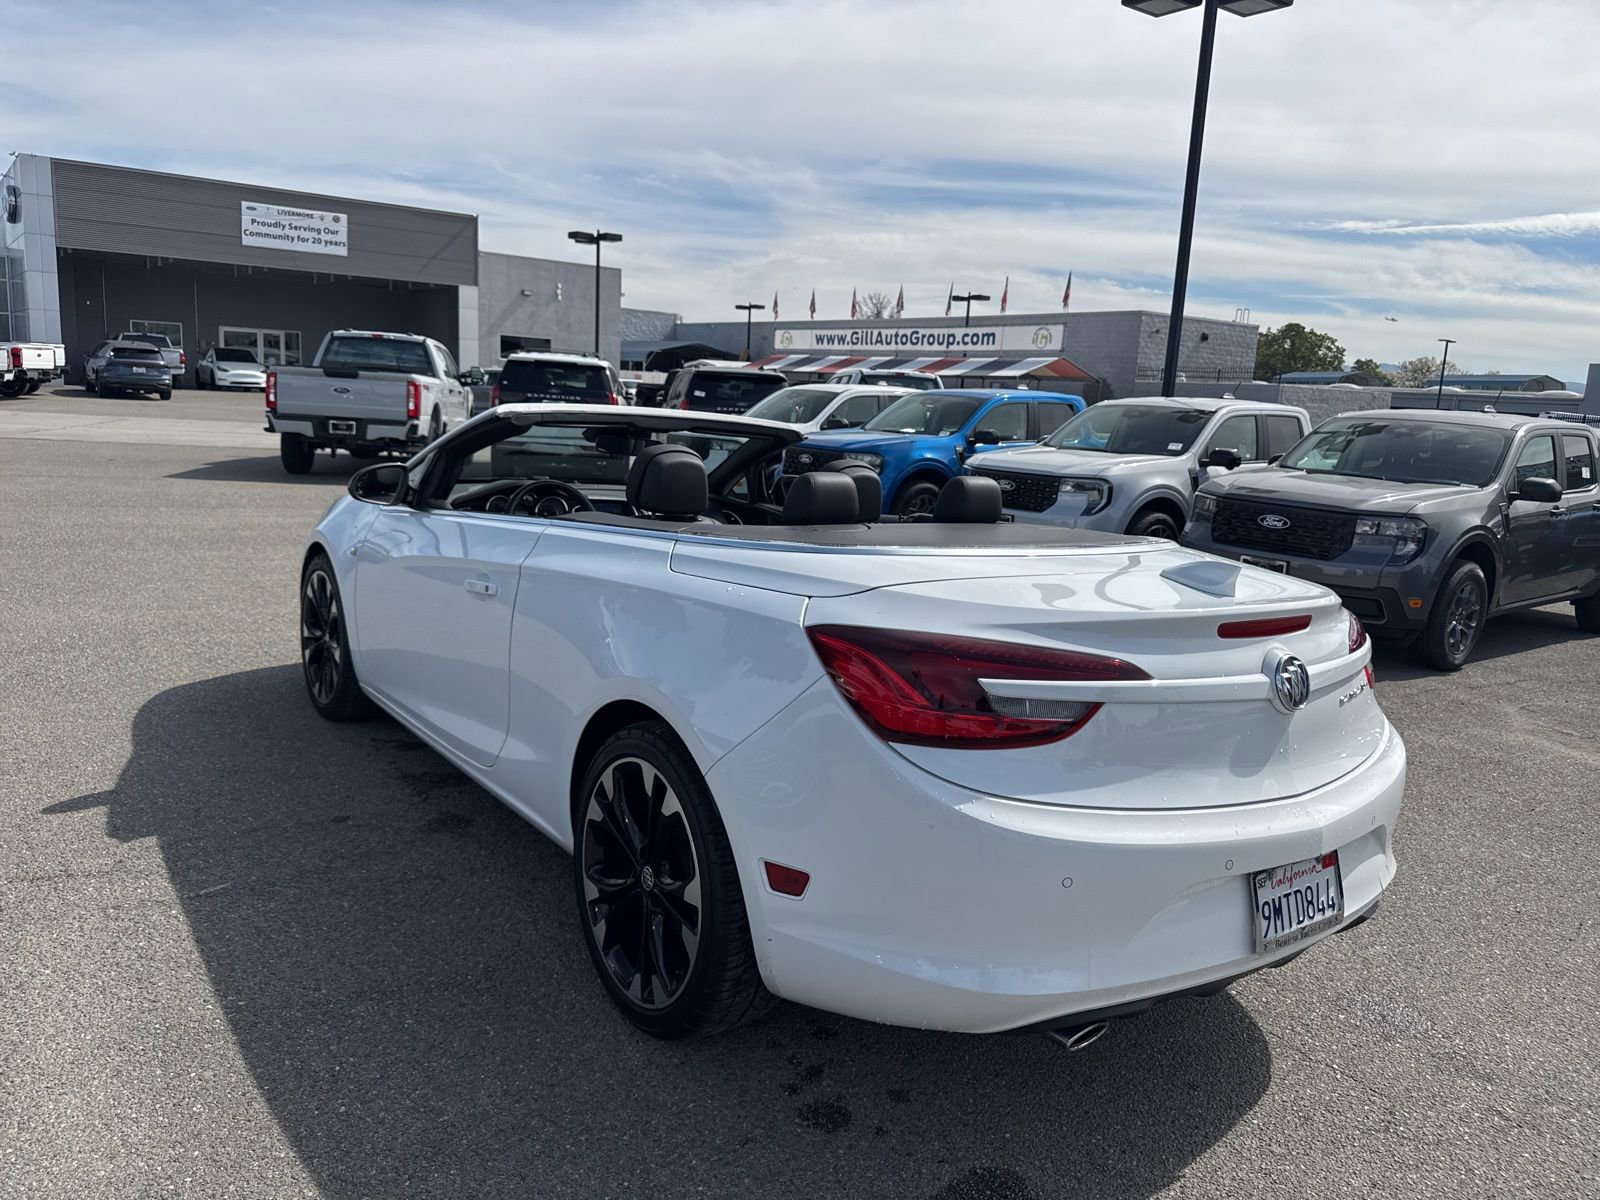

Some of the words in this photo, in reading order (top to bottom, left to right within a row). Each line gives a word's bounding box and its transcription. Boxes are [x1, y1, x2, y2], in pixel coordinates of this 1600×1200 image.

[277, 208, 315, 220] LIVERMORE
[250, 218, 286, 231] Proudly
[288, 223, 321, 235] Serving
[323, 227, 340, 236] Our
[243, 229, 295, 243] Community
[297, 235, 310, 243] for
[311, 237, 322, 245] 20
[324, 239, 346, 250] years
[815, 330, 996, 349] www.GillAutoGroup.com
[526, 392, 581, 401] EXPEDITION
[1261, 515, 1287, 528] Ford
[1270, 864, 1321, 889] California
[1261, 878, 1336, 939] 9MTD844
